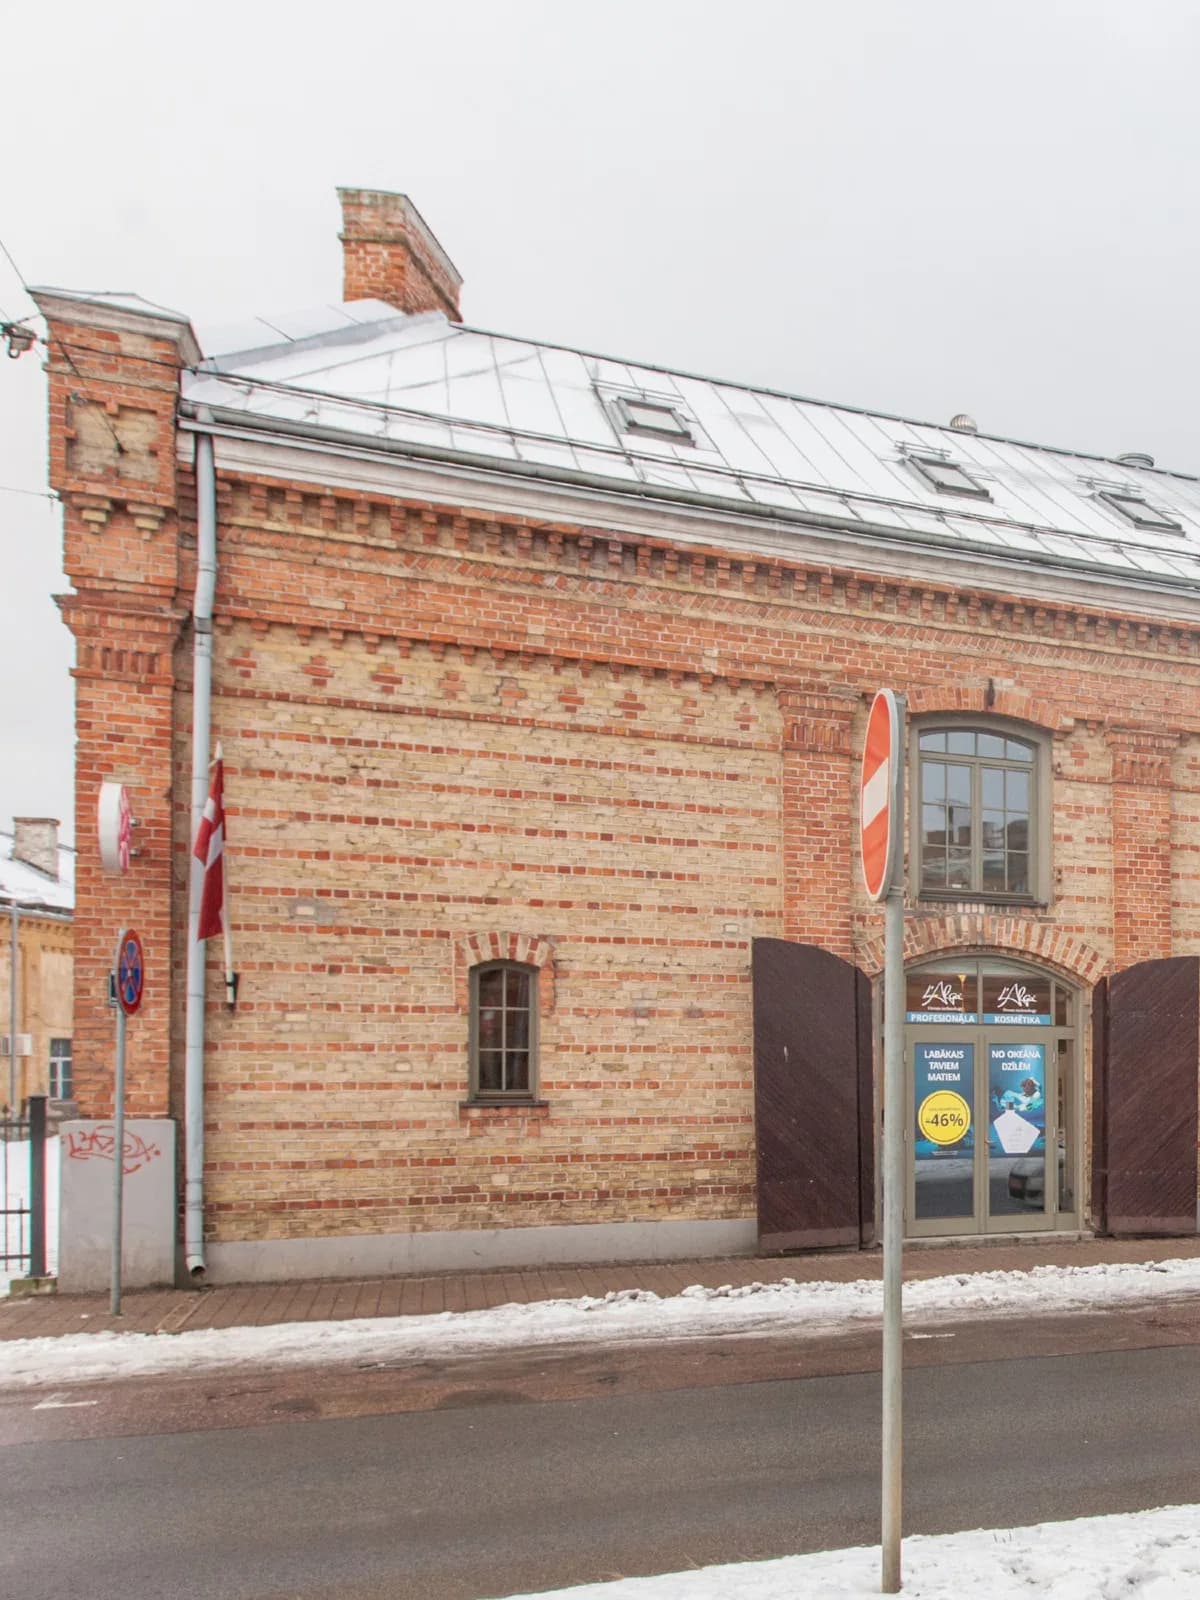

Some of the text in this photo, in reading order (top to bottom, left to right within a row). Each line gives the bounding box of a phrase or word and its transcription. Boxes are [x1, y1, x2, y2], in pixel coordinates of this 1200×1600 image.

[994, 1013, 1041, 1024] KOSMĒTIKA
[924, 1049, 964, 1059] LABĀKAIS
[991, 1050, 1004, 1059] NO
[929, 1061, 959, 1070] TAVIEM
[927, 1073, 961, 1081] MATIEM
[925, 1113, 964, 1127] -46%
